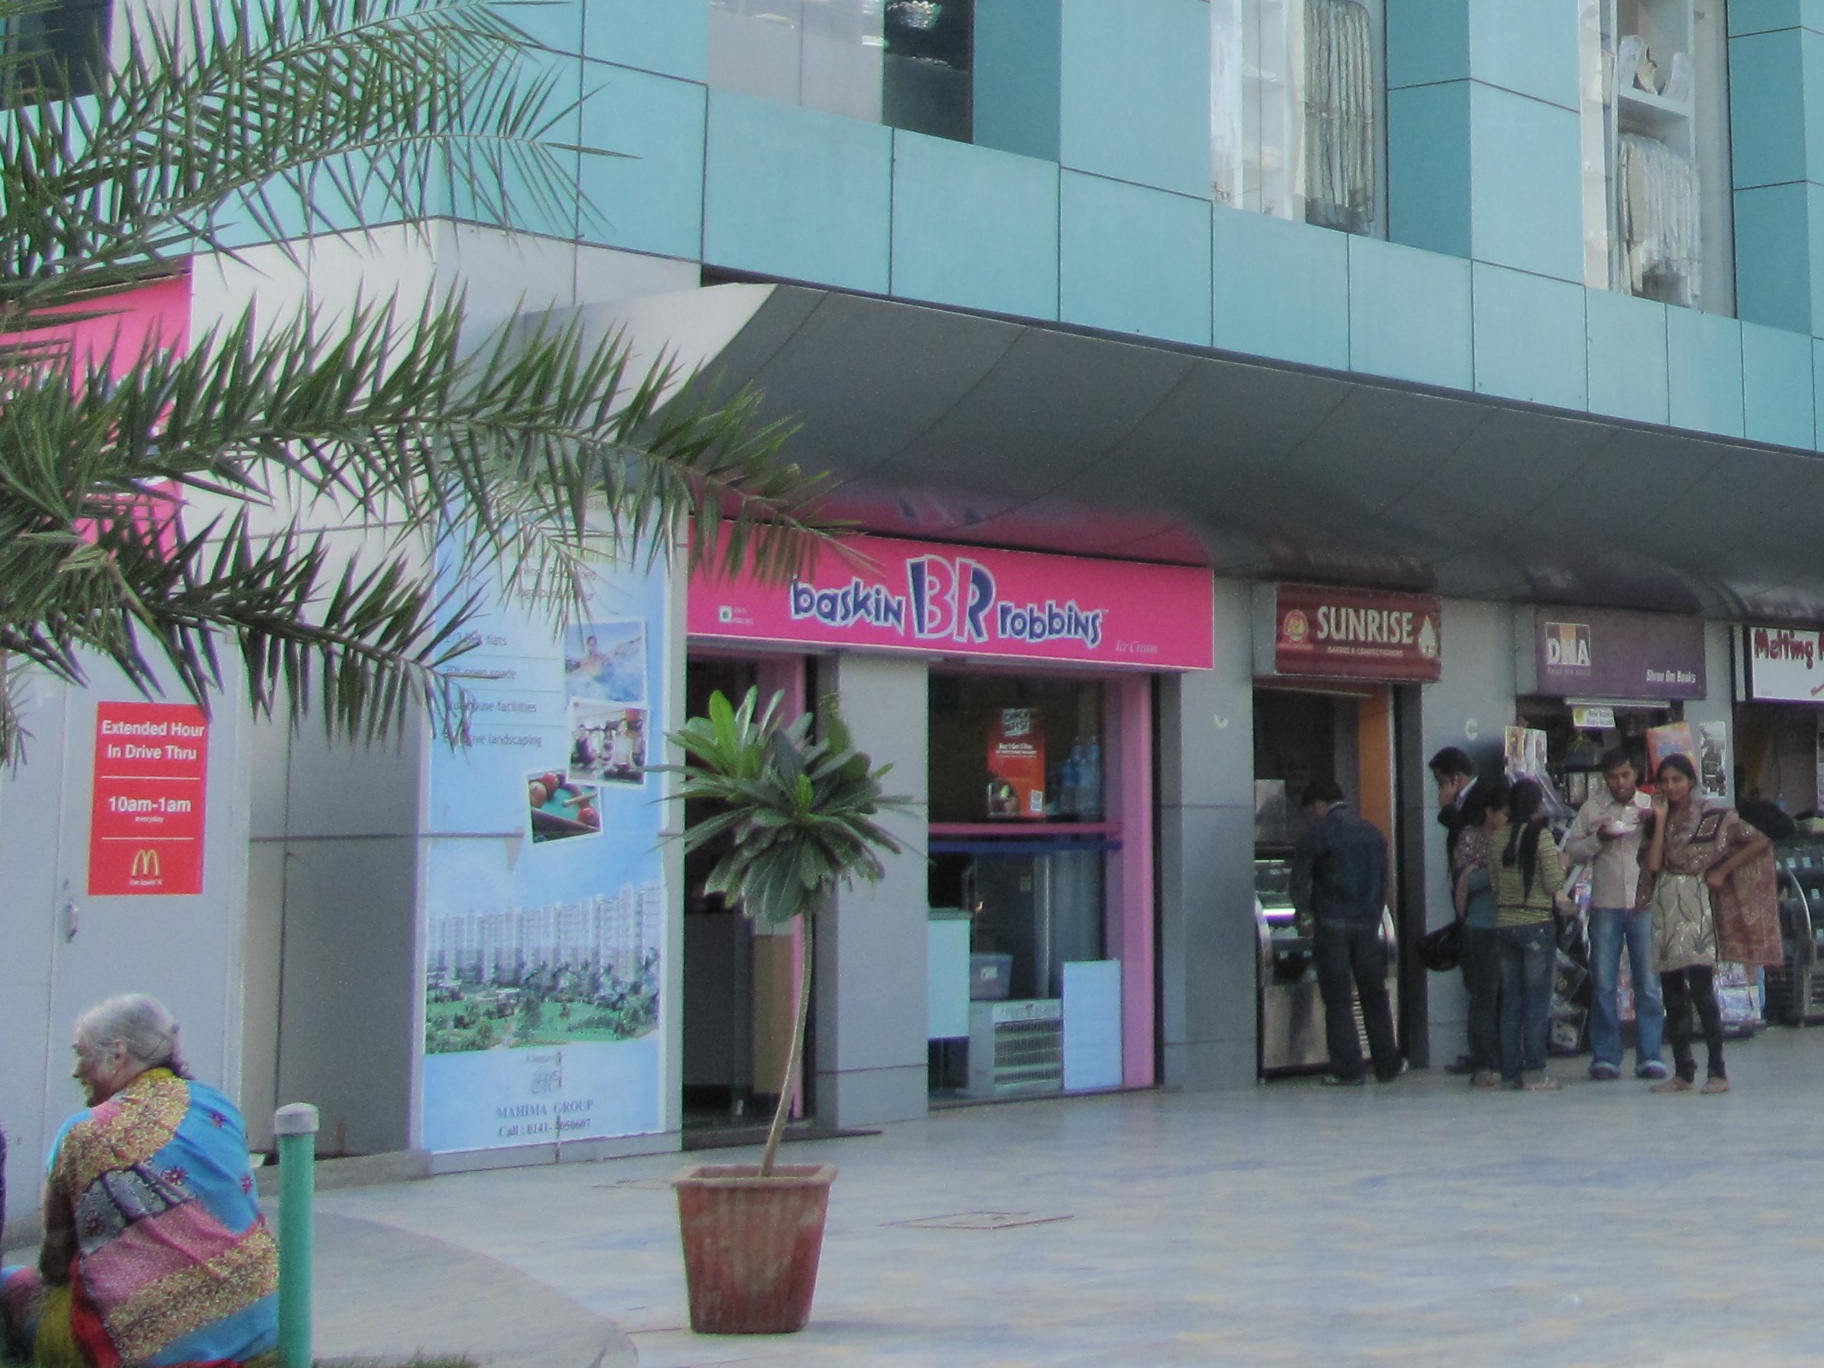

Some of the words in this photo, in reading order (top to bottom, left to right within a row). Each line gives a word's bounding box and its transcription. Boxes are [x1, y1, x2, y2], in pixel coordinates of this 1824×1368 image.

[790, 576, 905, 636] baskin
[906, 554, 998, 644] BR
[998, 600, 1103, 649] robbins
[1317, 605, 1414, 644] SUNRISE
[1546, 637, 1592, 666] DNA
[1754, 628, 1815, 670] Melting
[101, 720, 167, 736] Extended
[171, 722, 205, 737] Hour
[108, 744, 121, 758] In
[125, 744, 162, 759] Drive
[165, 745, 197, 760] Thru
[108, 796, 192, 812] 10am-1am
